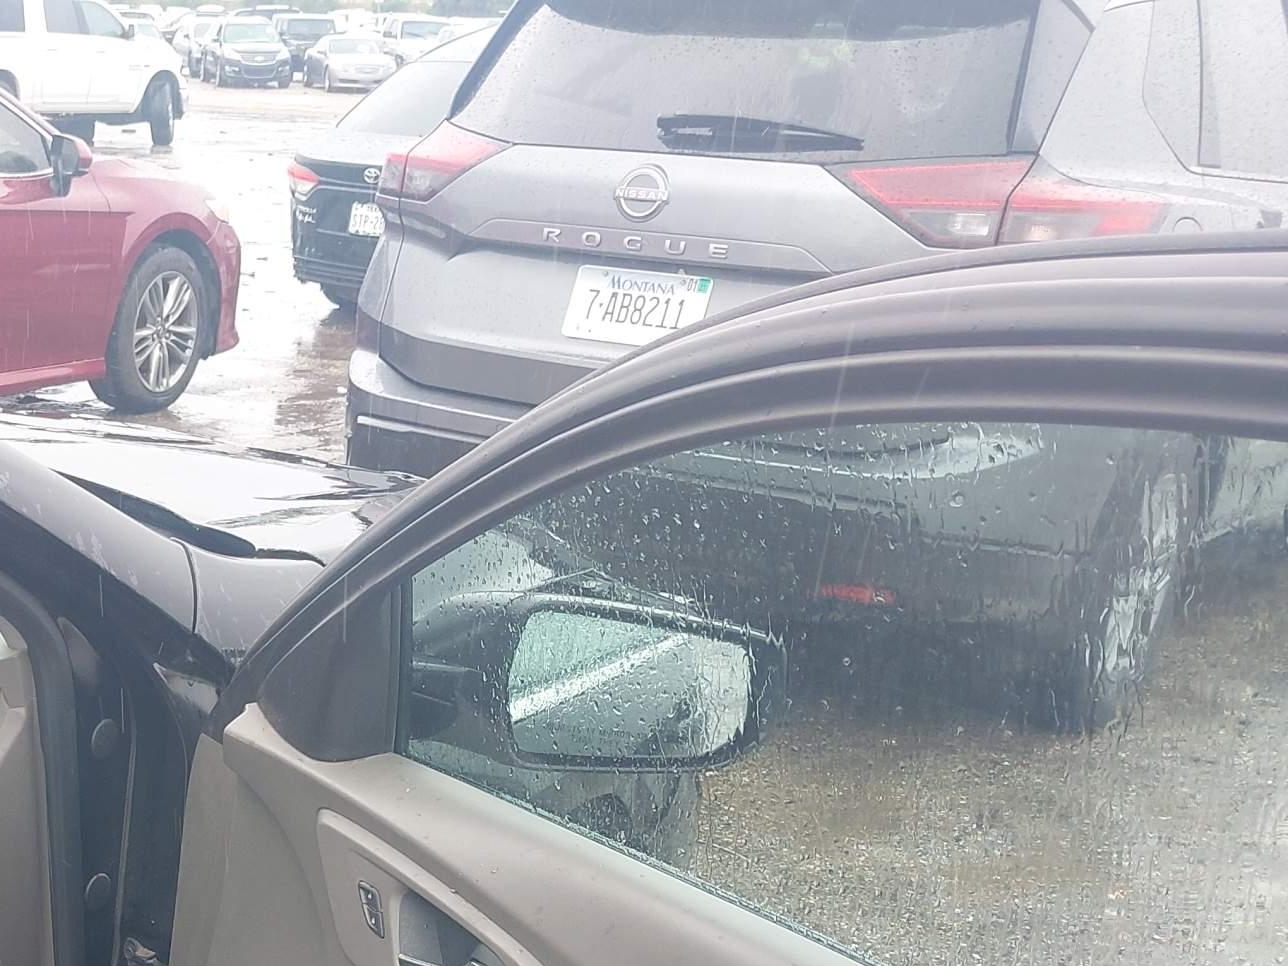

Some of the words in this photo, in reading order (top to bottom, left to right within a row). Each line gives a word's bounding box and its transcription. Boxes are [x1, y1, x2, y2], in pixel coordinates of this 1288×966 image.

[615, 187, 669, 201] NISSAN
[542, 227, 729, 259] ROGUE
[608, 274, 675, 296] MONTANA
